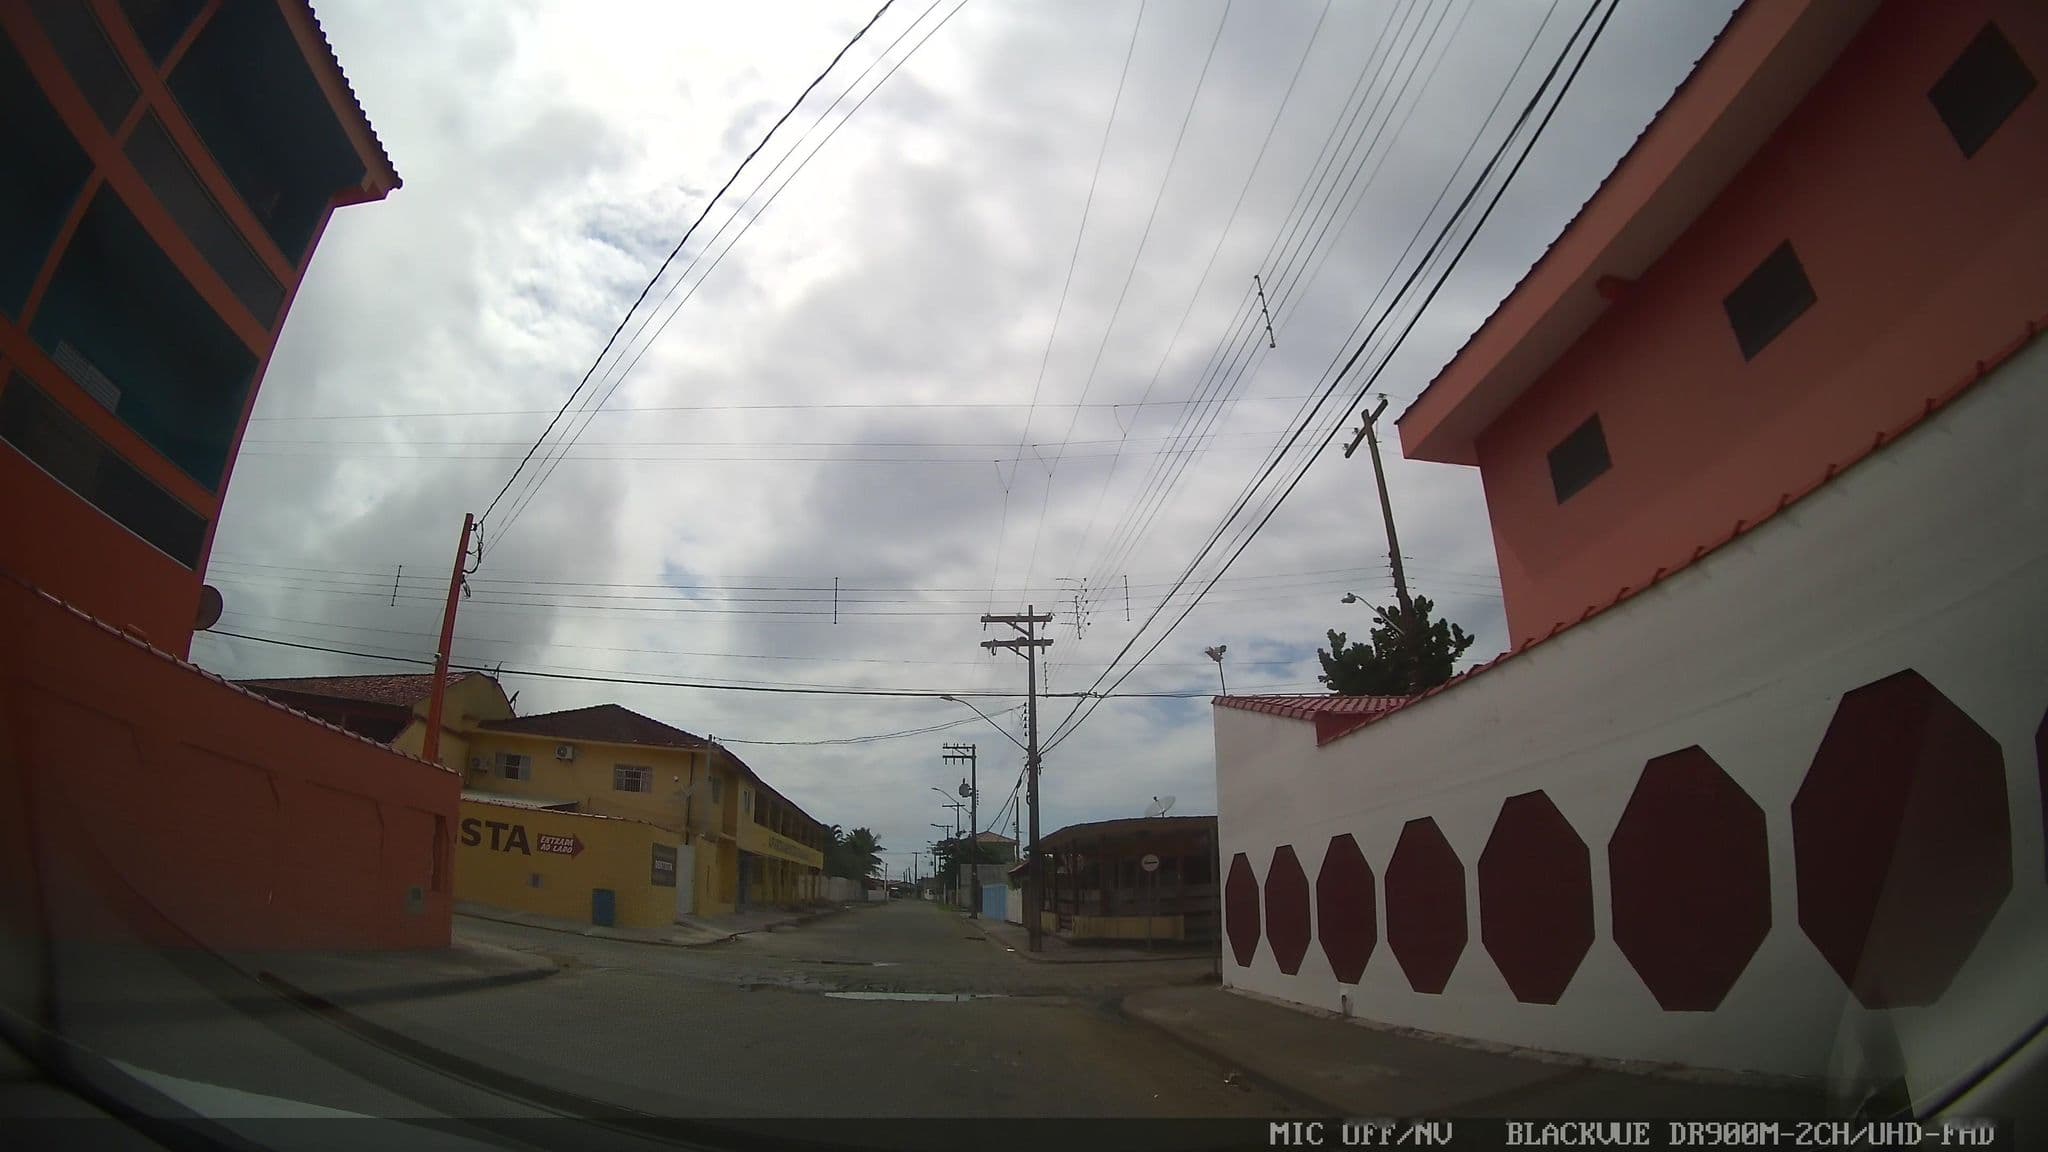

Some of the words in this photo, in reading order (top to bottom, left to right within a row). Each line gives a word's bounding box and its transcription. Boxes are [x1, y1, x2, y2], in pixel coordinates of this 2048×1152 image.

[455, 818, 531, 856] STA
[540, 835, 574, 846] ENTRADA
[540, 843, 551, 851] AO
[552, 845, 573, 853] LADO
